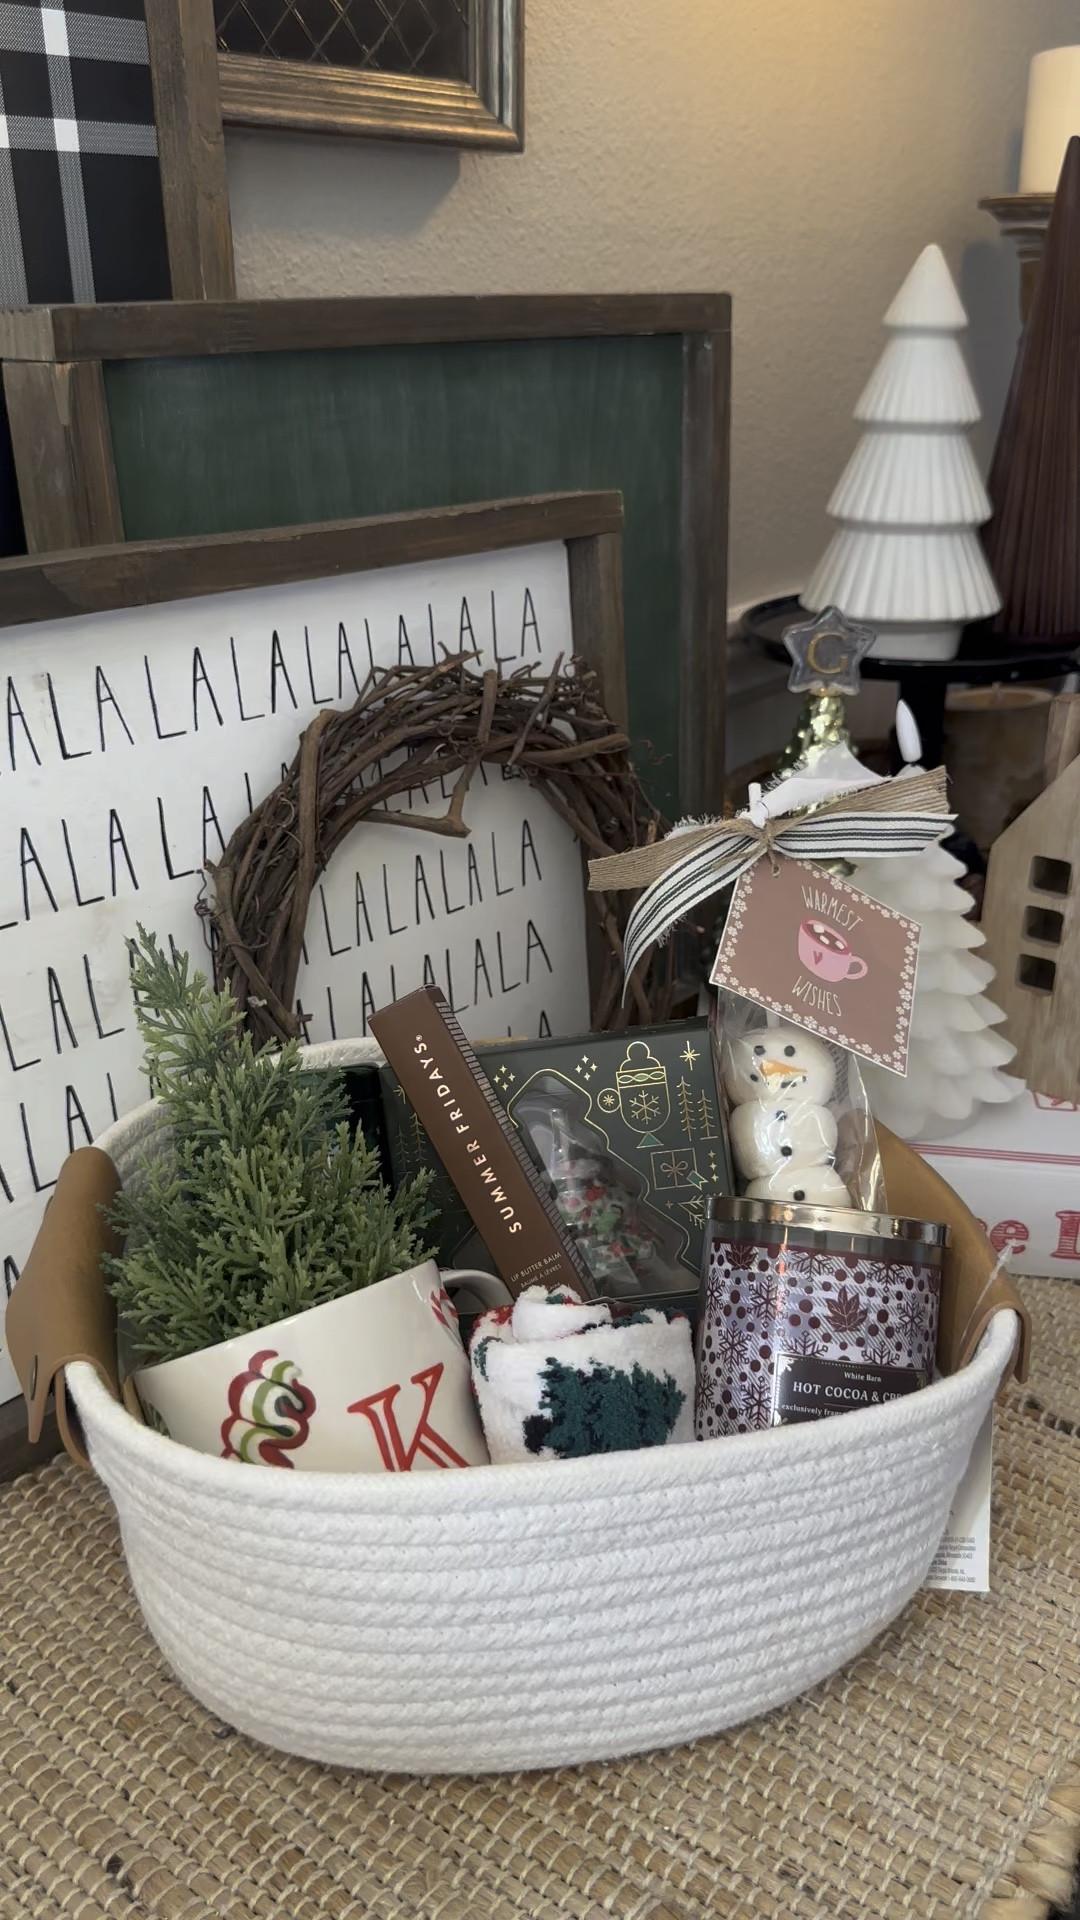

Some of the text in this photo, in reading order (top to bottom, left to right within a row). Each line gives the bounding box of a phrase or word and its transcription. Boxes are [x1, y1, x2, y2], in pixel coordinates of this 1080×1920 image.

[800, 885, 864, 931] WARMEST
[791, 976, 843, 1017] WISHES
[466, 1139, 522, 1234] SUMMER
[510, 1252, 562, 1282] LIP BUTTER BALM
[521, 1275, 539, 1288] BAUME
[792, 1381, 821, 1395] HOT
[825, 1385, 868, 1402] COCOA
[871, 1390, 880, 1402] &
[844, 1371, 882, 1383] White Barn
[347, 1362, 471, 1472] K
[782, 1404, 823, 1416] exclusively
